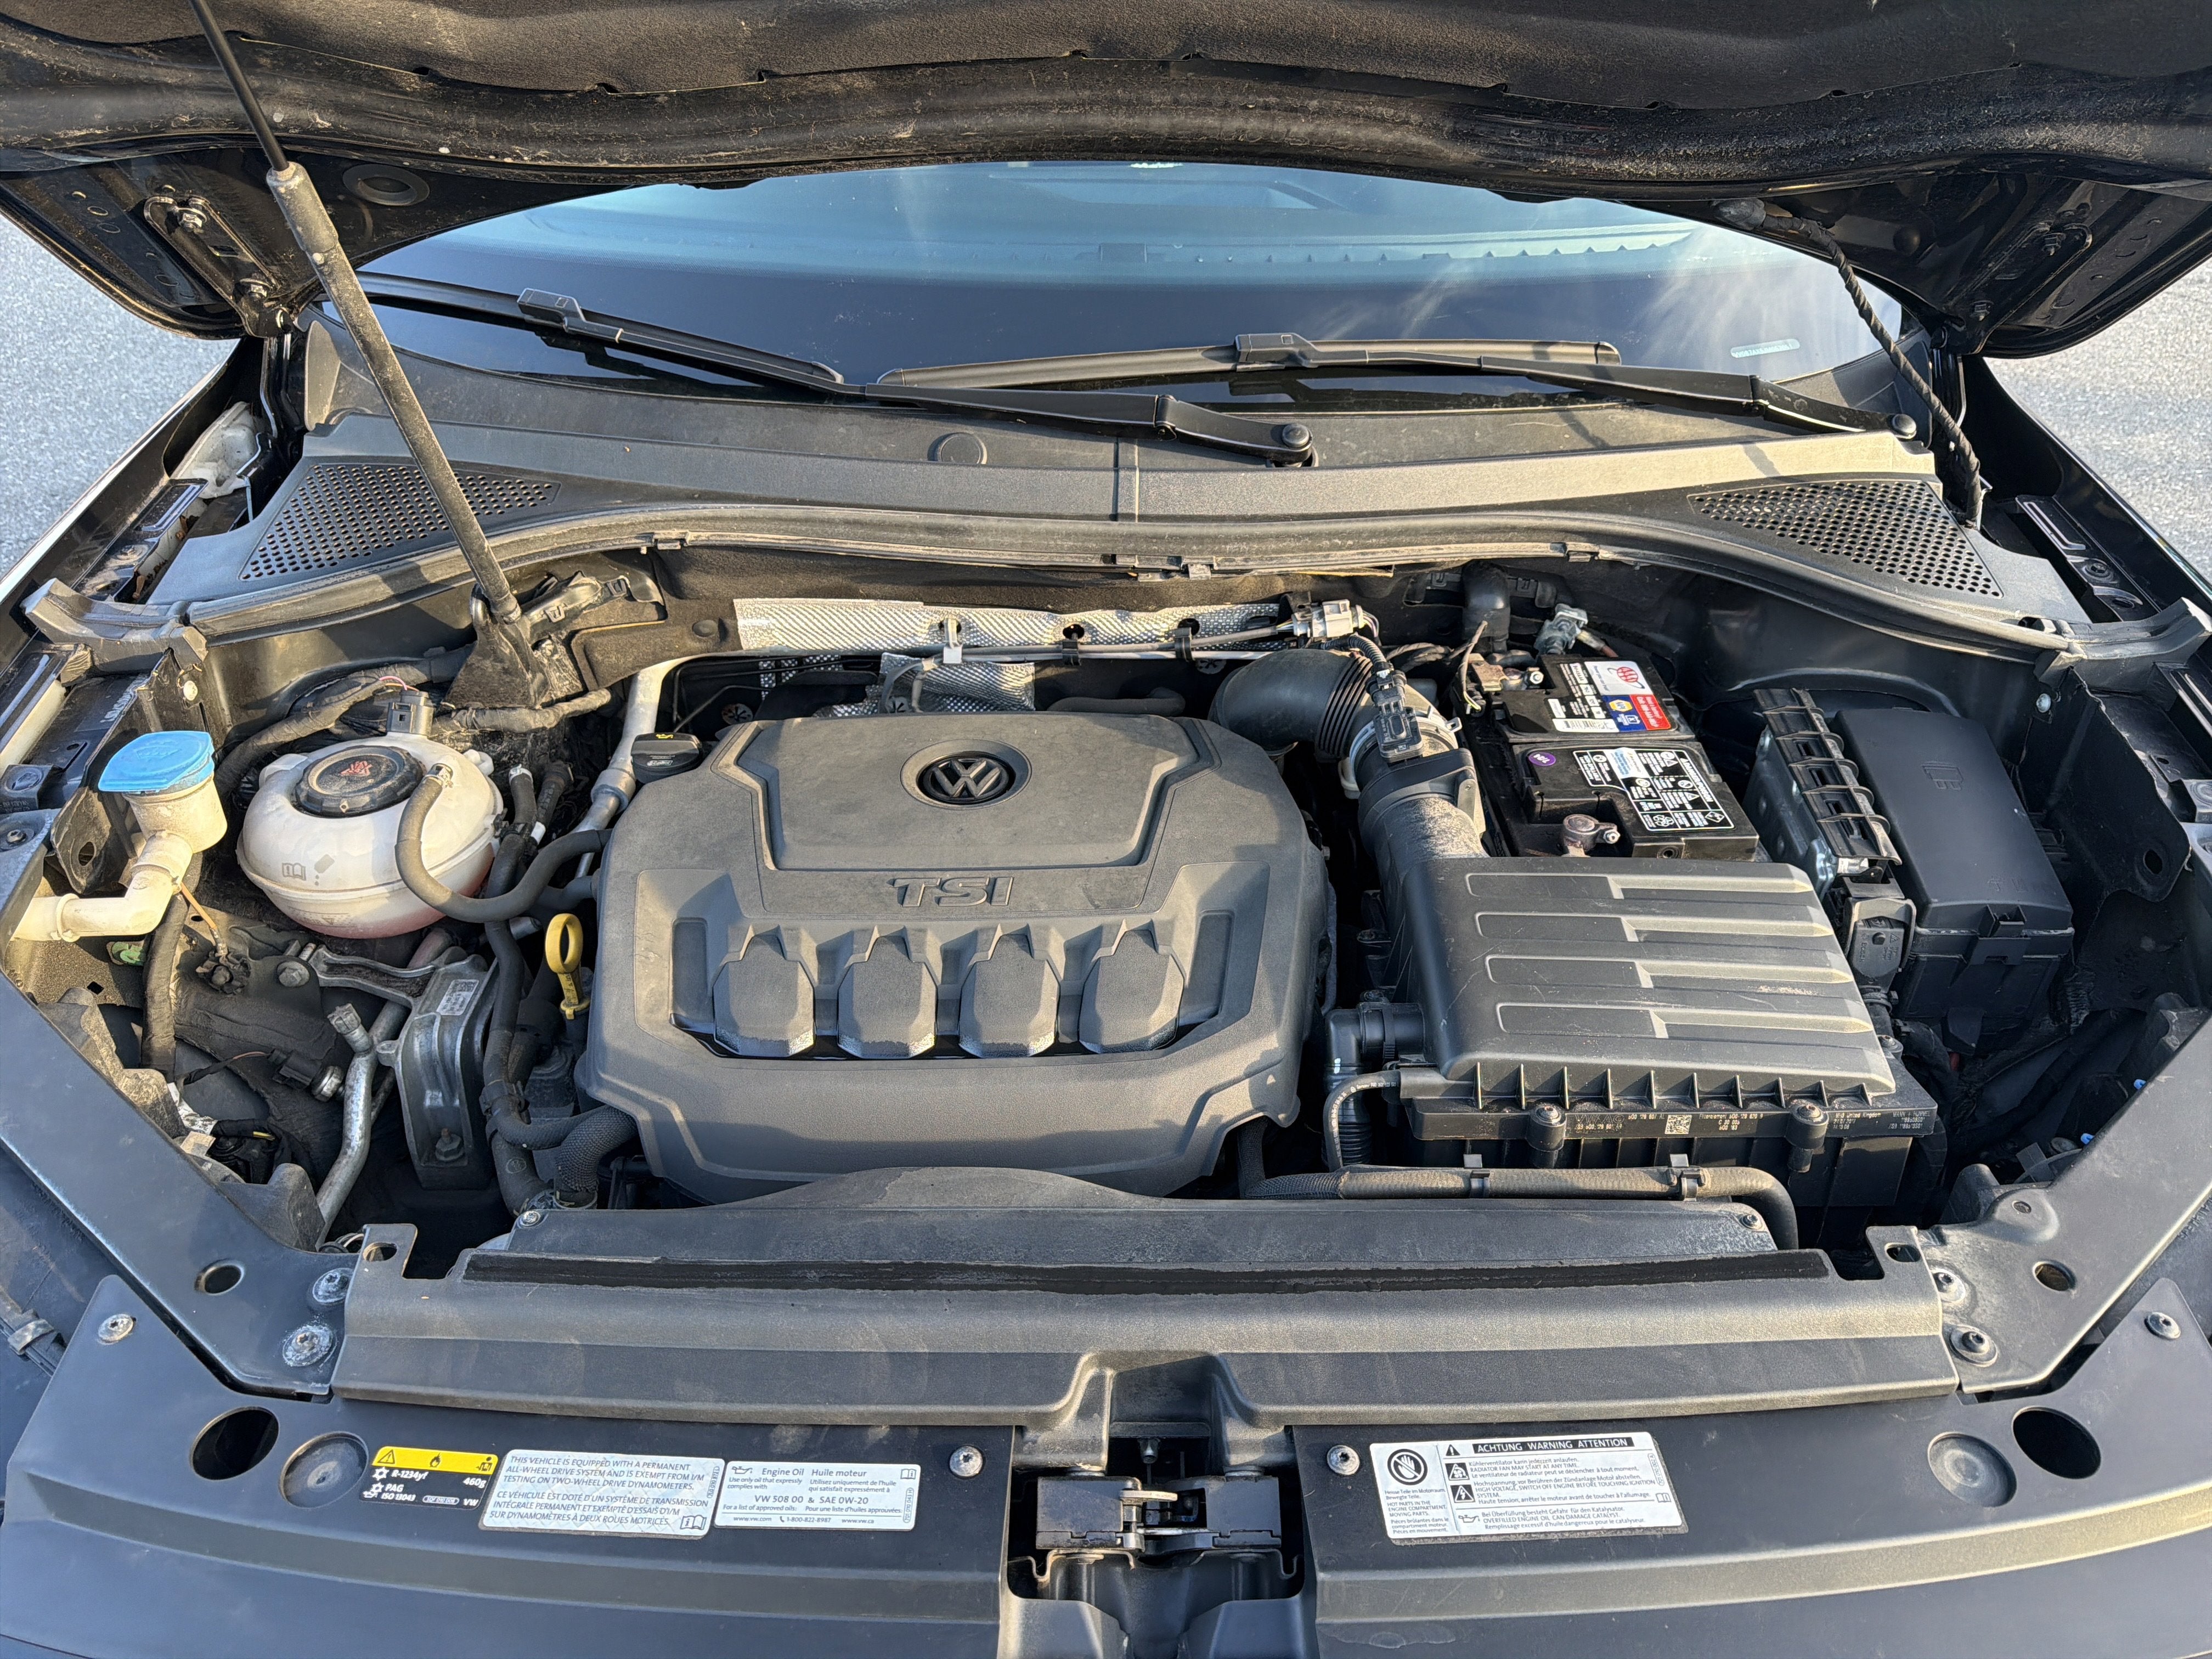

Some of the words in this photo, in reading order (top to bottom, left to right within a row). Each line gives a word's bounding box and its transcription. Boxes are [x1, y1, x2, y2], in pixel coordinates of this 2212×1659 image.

[892, 876, 1015, 907] TSI
[1476, 1443, 1523, 1452] ACHTUNG
[1527, 1441, 1573, 1449] WARNING
[1576, 1438, 1628, 1448] ATTENTION
[641, 1462, 690, 1470] PERMANENT
[390, 1469, 428, 1482] R-1234yf
[505, 1465, 551, 1474] ALL-WHEEL
[635, 1471, 666, 1479] EXEMPT
[761, 1468, 791, 1476] Engine
[461, 1476, 487, 1488] 460g
[502, 1475, 536, 1483] TESTING
[551, 1477, 602, 1486] TWO-WHEEL
[385, 1483, 404, 1492] PAG
[534, 1502, 582, 1511] PERMANENT
[651, 1497, 709, 1506] TRANSMISSION
[489, 1510, 507, 1518] SUR
[579, 1514, 601, 1522] DEUX
[602, 1515, 629, 1524] ROUES
